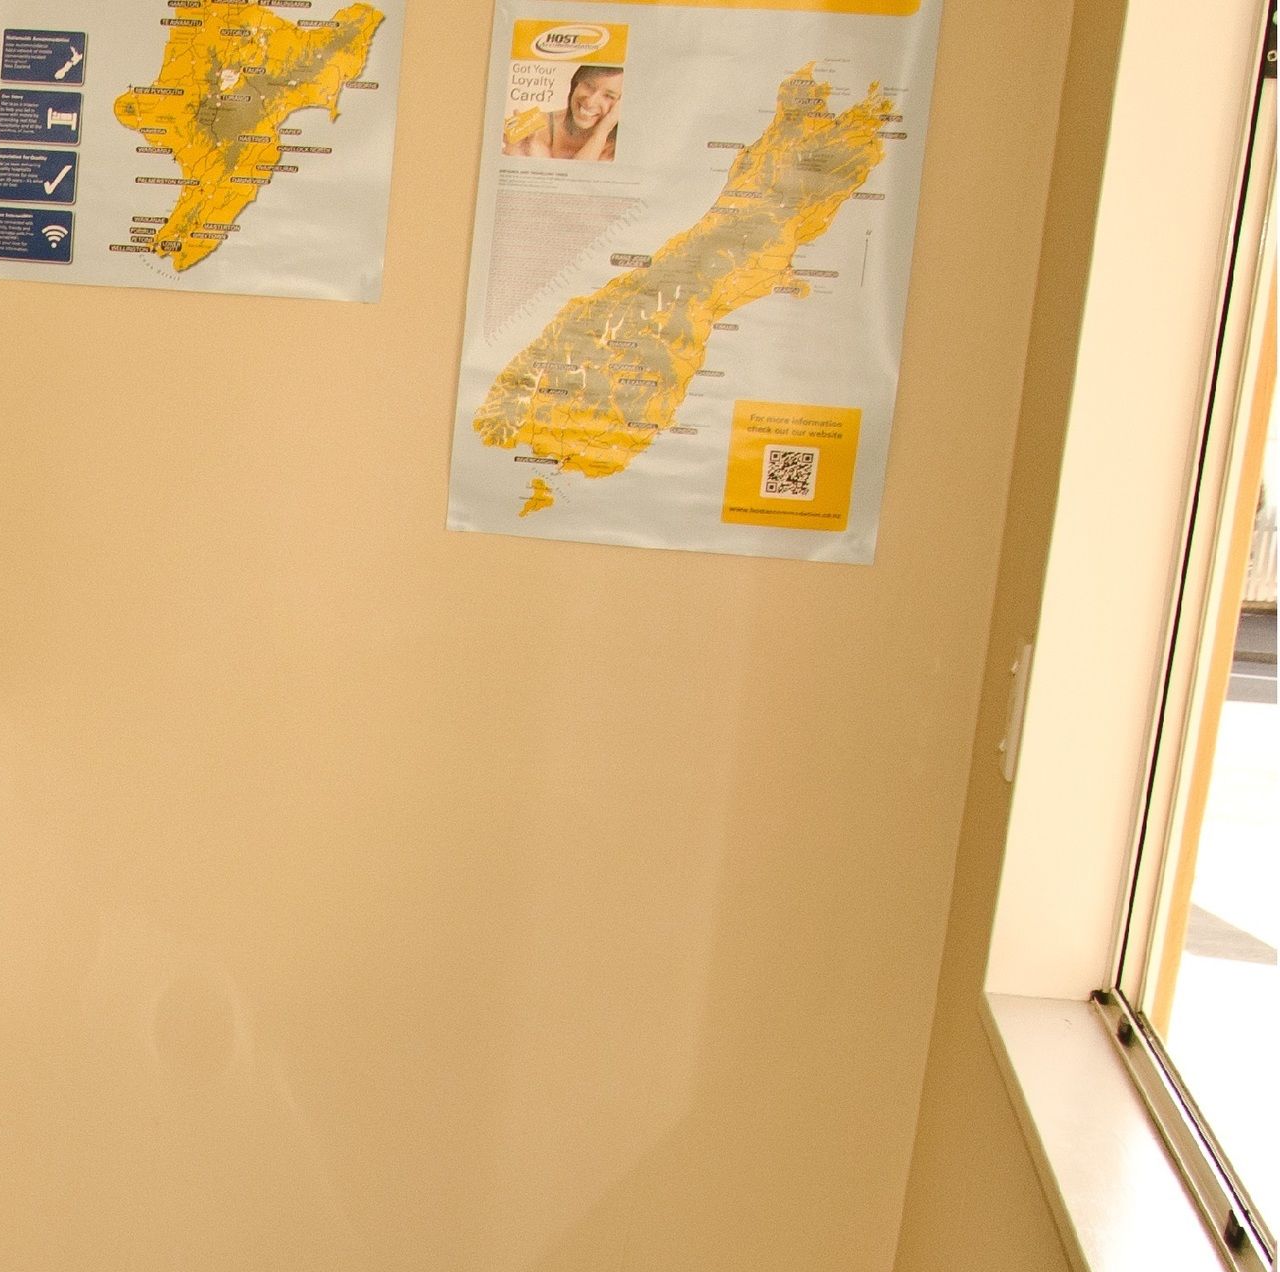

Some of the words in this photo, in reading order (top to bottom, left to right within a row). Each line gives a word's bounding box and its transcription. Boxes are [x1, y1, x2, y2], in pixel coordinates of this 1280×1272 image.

[546, 33, 580, 44] HOST
[512, 63, 531, 74] Got
[534, 64, 556, 75] Your
[512, 75, 556, 88] Loyalty
[510, 88, 554, 102] Card?
[750, 414, 765, 423] For
[767, 416, 790, 424] more
[791, 416, 842, 428] information
[747, 426, 772, 434] check
[775, 428, 789, 436] out
[809, 430, 843, 440] website
